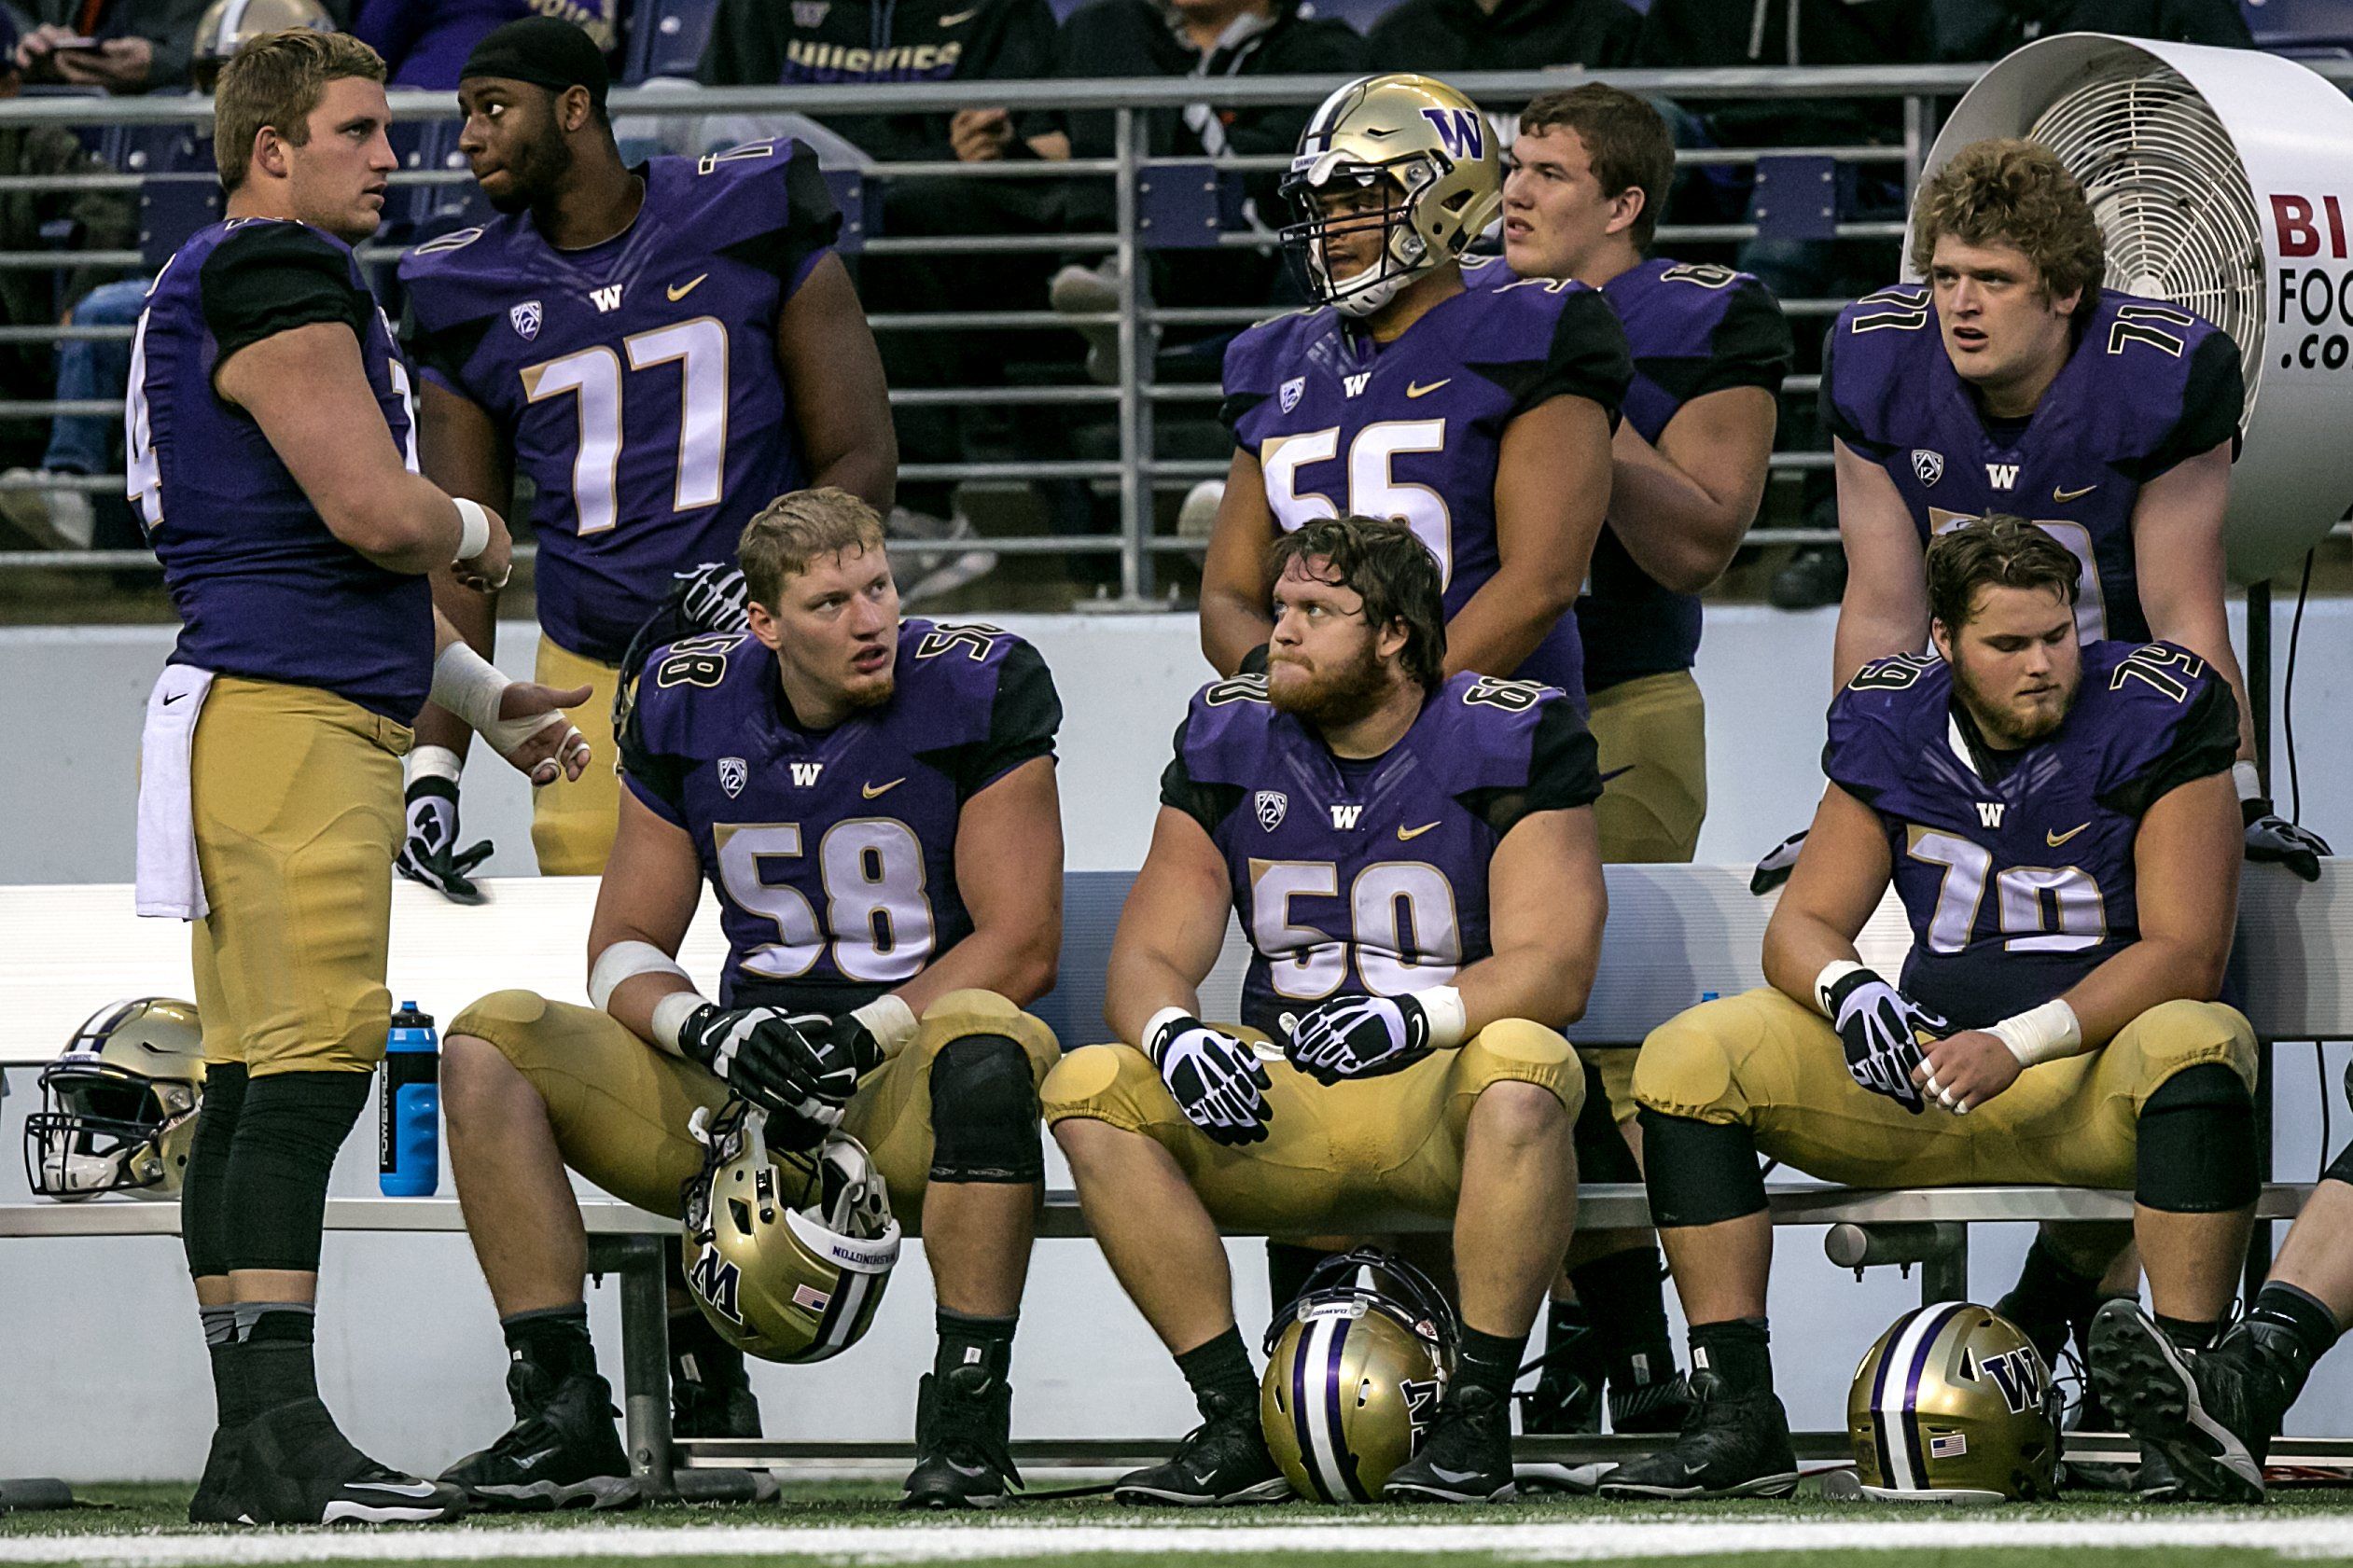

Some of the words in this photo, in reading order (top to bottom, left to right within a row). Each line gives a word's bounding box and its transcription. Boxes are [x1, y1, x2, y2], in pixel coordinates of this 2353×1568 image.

[1419, 106, 1484, 161] W
[589, 284, 623, 313] W
[1344, 372, 1371, 399] W
[519, 315, 730, 537] 77
[1984, 464, 2020, 490] W
[789, 763, 824, 787] W
[1262, 808, 1276, 824] 12
[1330, 805, 1362, 829] W
[1976, 802, 2005, 828] W
[713, 817, 936, 982] 58
[1979, 1346, 2041, 1415] W
